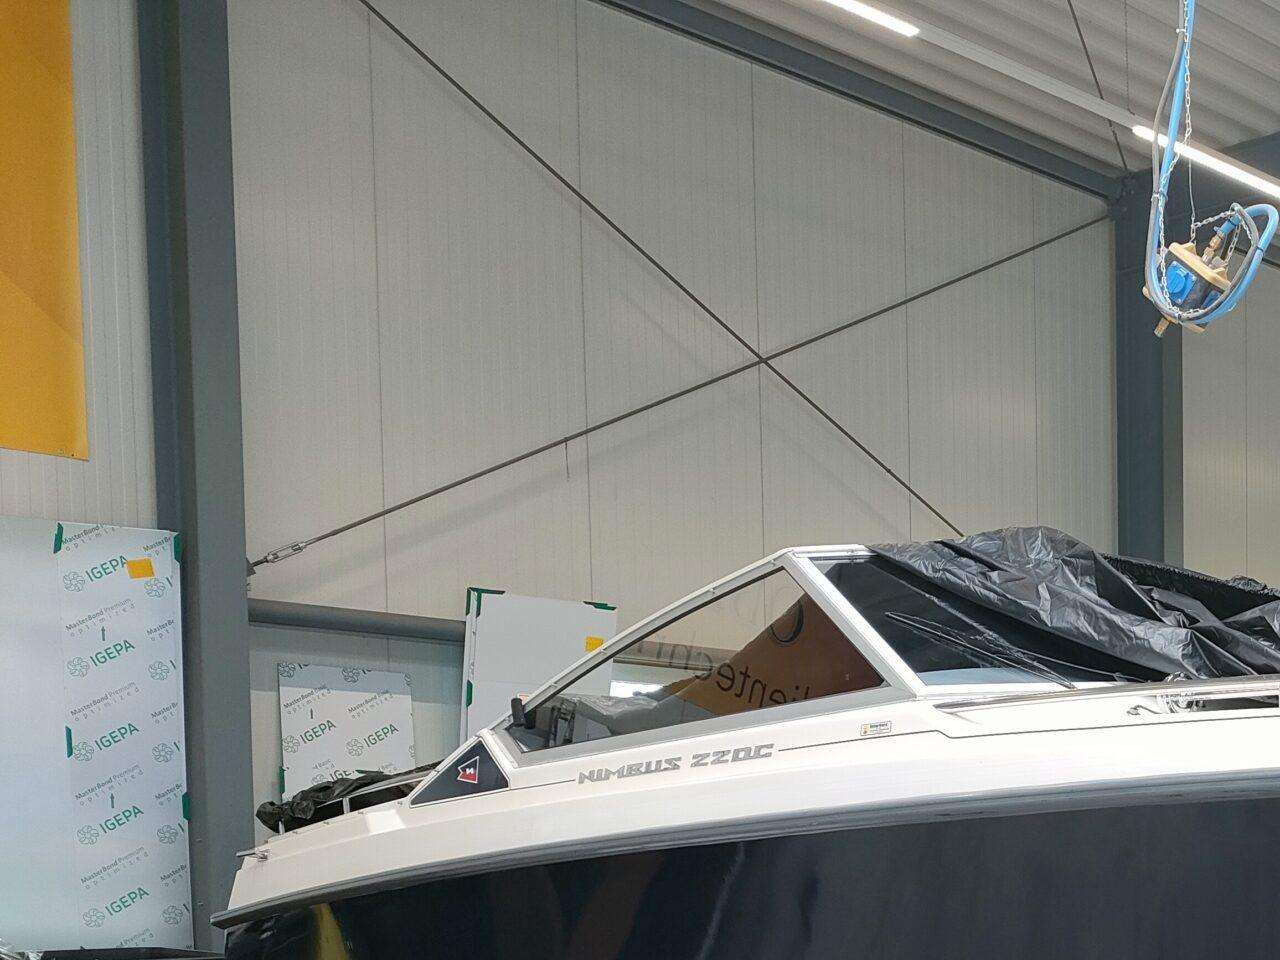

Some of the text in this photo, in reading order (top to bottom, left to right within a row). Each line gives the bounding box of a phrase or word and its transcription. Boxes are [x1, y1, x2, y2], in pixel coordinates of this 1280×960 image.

[86, 555, 128, 582] IGEPA
[90, 639, 135, 666] IGEPA
[95, 723, 139, 750] IGEPA
[300, 720, 336, 744] IGEPA
[364, 724, 399, 747] IGEPA
[578, 743, 775, 784] NIMBUS 220C
[100, 805, 144, 834] IGEPA
[105, 887, 149, 916] IGEPA
